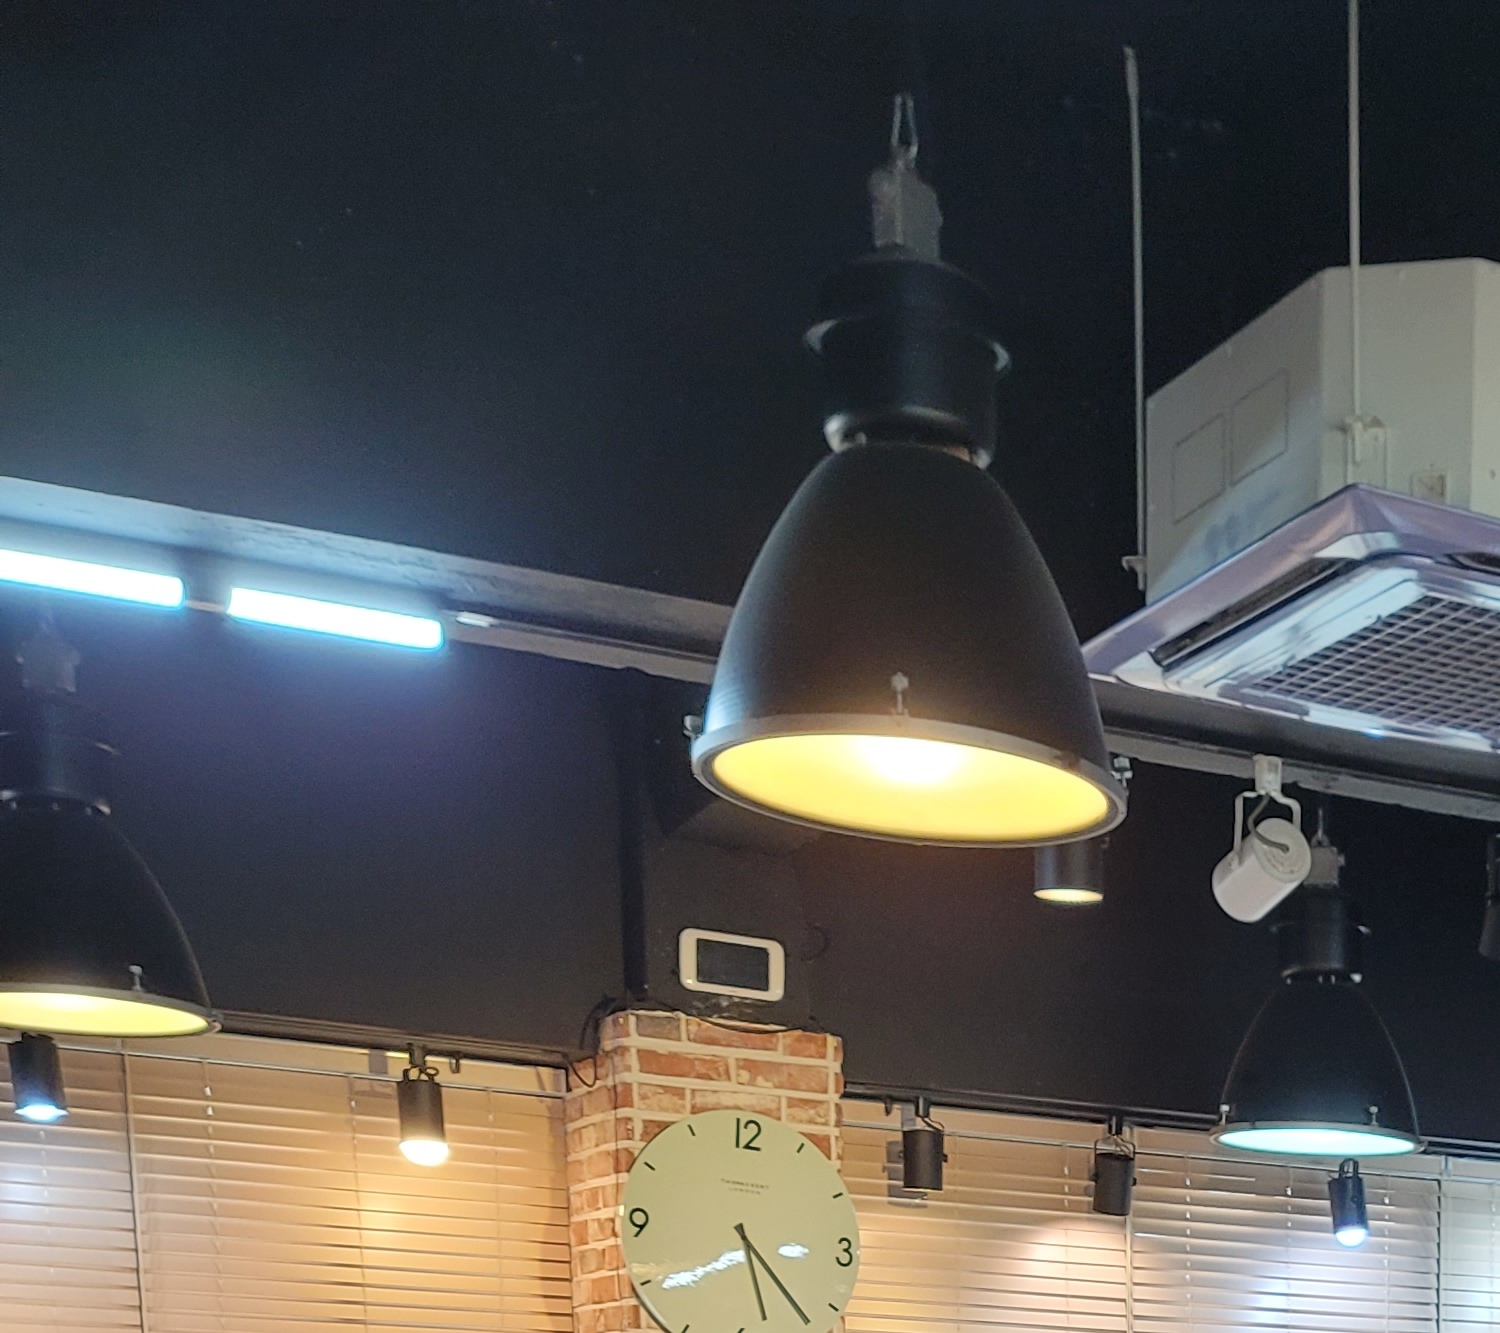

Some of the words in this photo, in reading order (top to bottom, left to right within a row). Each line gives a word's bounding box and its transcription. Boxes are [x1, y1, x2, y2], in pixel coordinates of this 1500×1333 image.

[736, 1117, 762, 1151] 12
[629, 1208, 649, 1237] 9
[835, 1237, 853, 1267] 3
